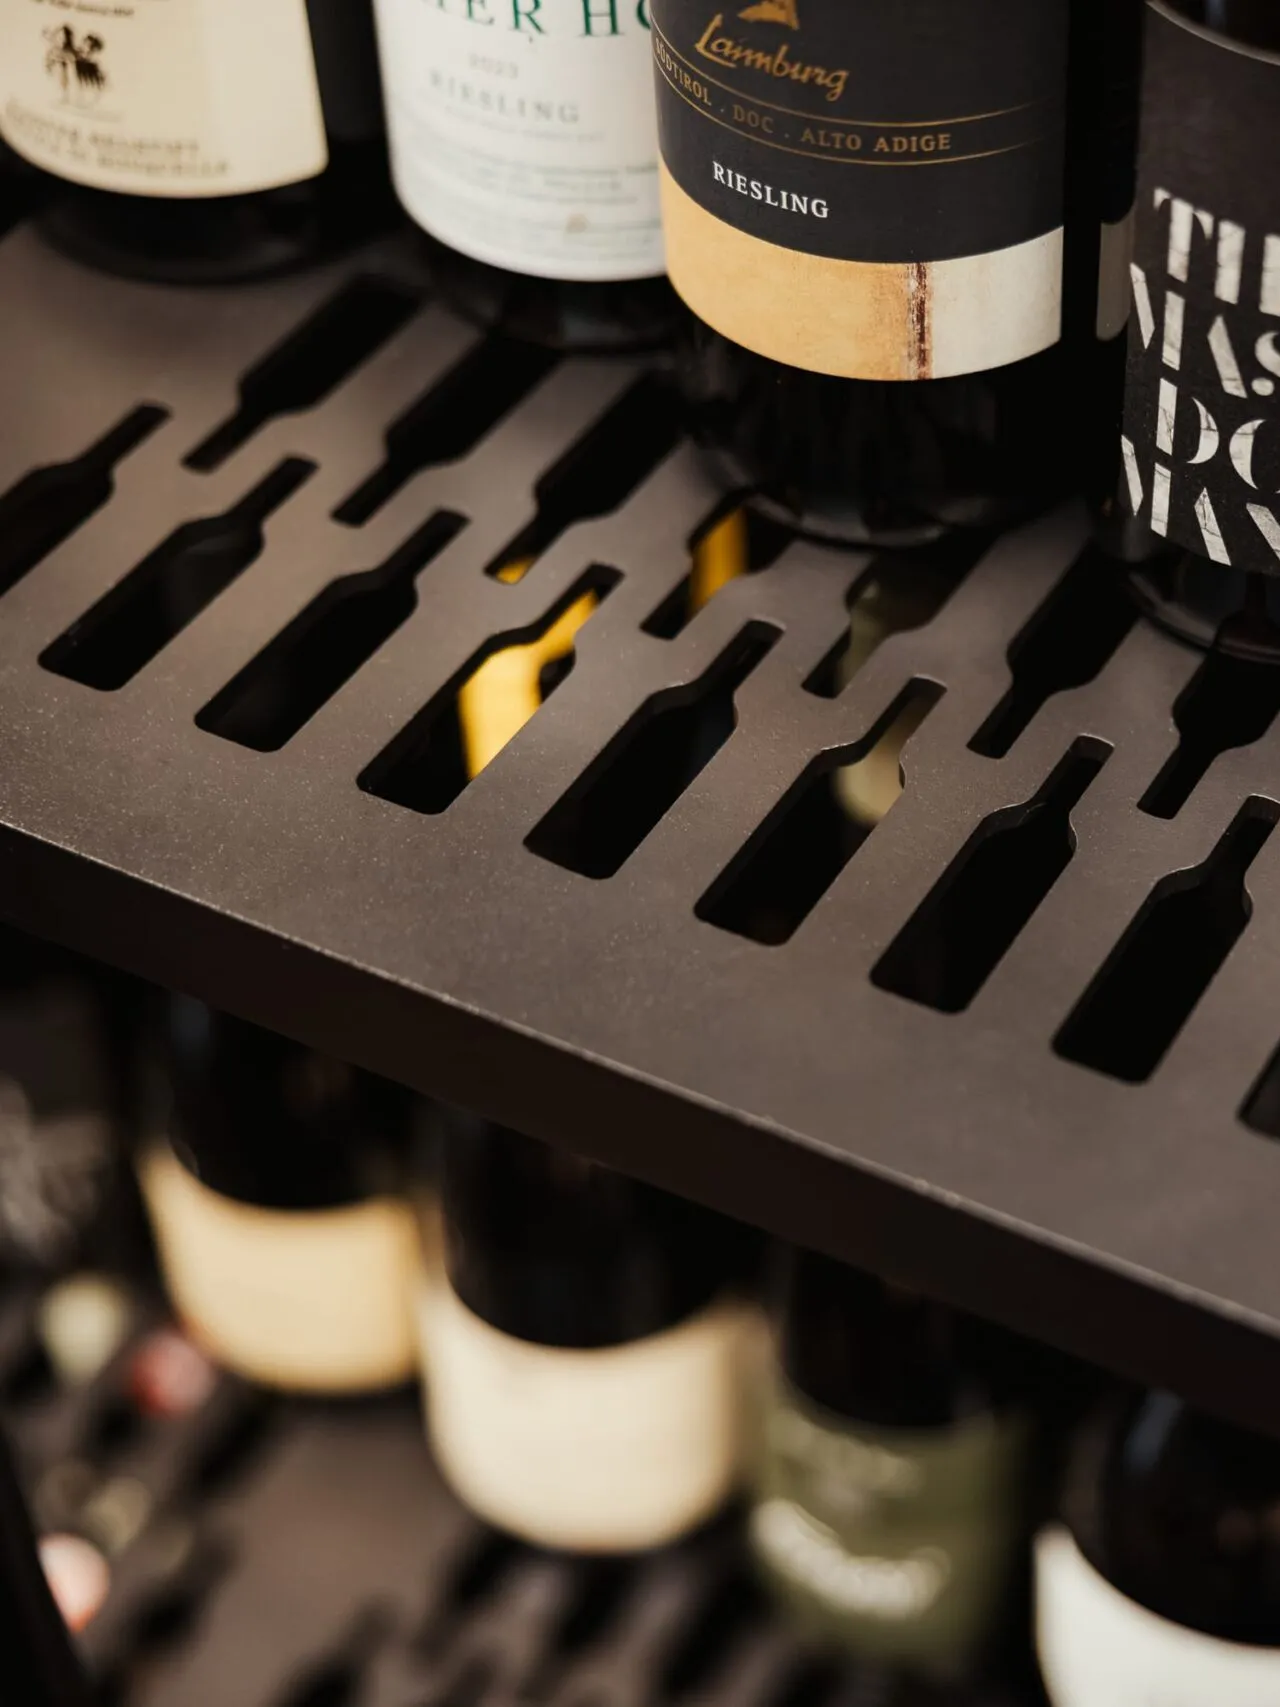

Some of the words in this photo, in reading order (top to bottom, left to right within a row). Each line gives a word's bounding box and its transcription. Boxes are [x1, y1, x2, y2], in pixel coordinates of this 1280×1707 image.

[655, 37, 712, 106] SÜDTIROL
[733, 104, 774, 133] DOC
[801, 127, 862, 151] ALTO
[873, 133, 952, 152] ADIGE
[712, 161, 829, 218] RIESLING
